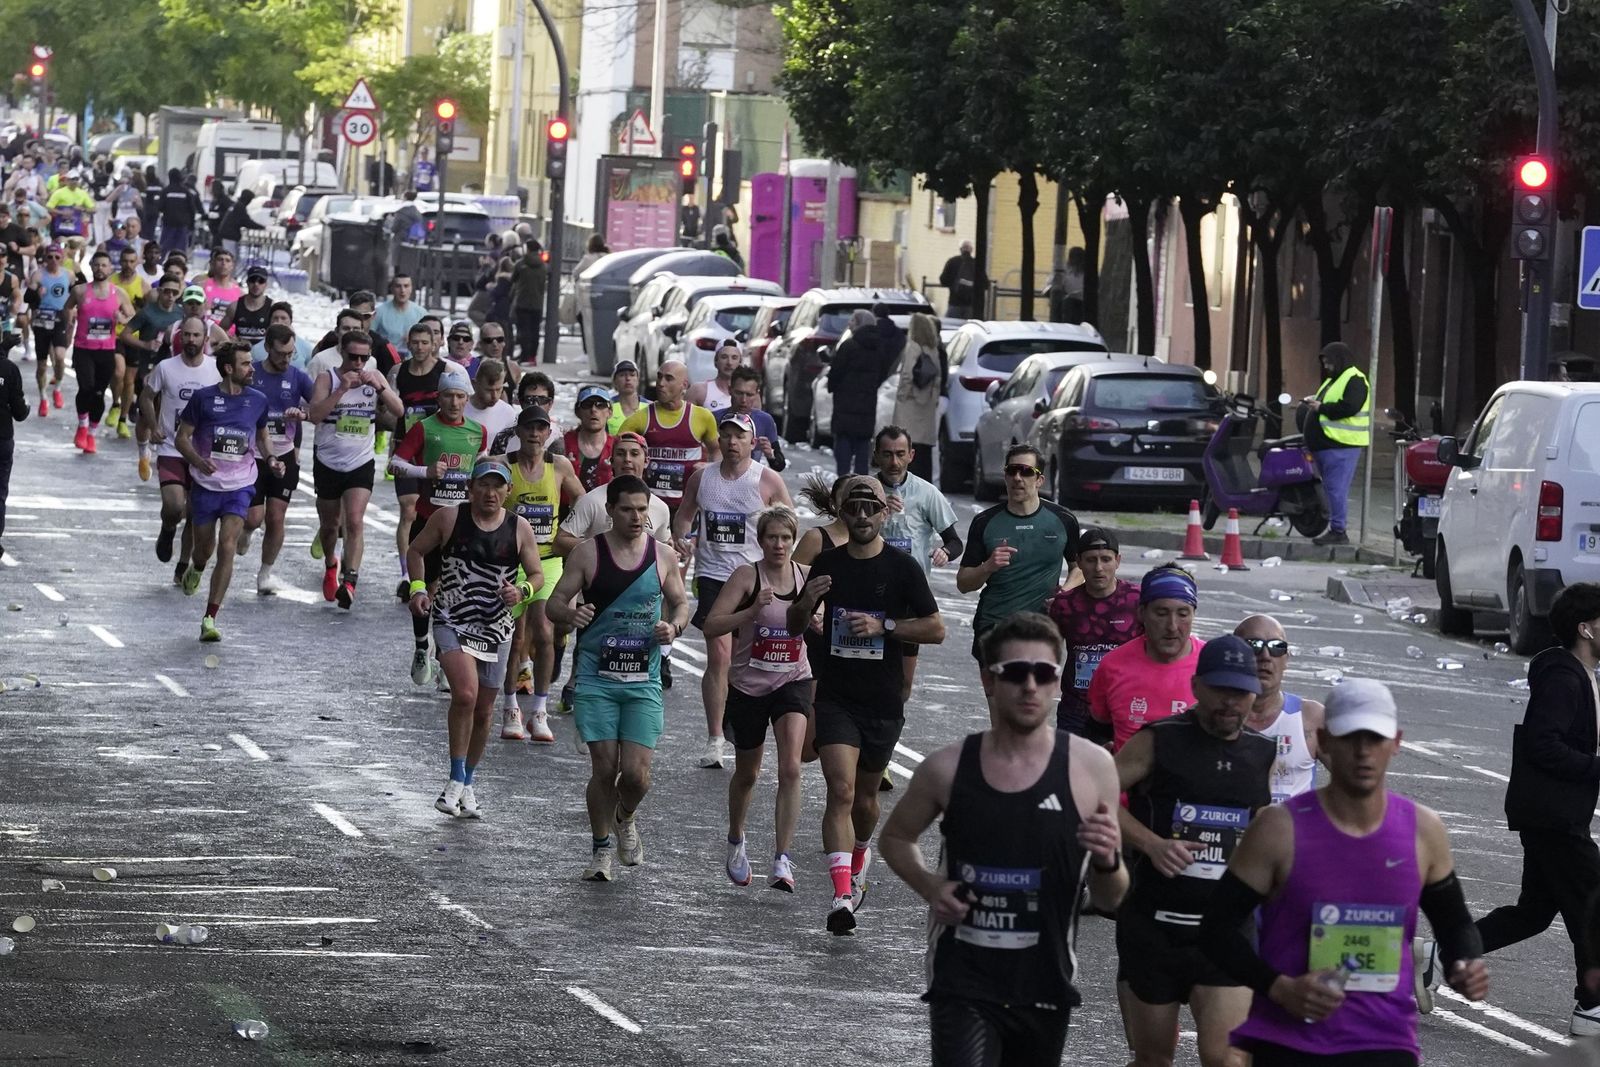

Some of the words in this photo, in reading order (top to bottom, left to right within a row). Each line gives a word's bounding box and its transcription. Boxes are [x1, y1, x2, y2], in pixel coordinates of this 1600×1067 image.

[349, 122, 370, 134] 30
[343, 425, 362, 433] STEVE
[222, 444, 239, 454] LOÏC
[1161, 469, 1183, 480] GBR
[656, 480, 672, 489] NEIL
[434, 489, 466, 499] MARCOS
[716, 513, 741, 521] ZURICH
[466, 639, 488, 651] DAVID
[619, 639, 645, 647] ZURICH
[838, 635, 875, 647] MIGUEL
[763, 651, 791, 662] AOIFE
[609, 661, 641, 672] OLIVER
[1200, 810, 1241, 823] ZURICH
[1198, 831, 1221, 843] 4914
[980, 872, 1030, 885] ZURICH
[972, 909, 1018, 930] MATT
[1343, 908, 1395, 923] ZURICH
